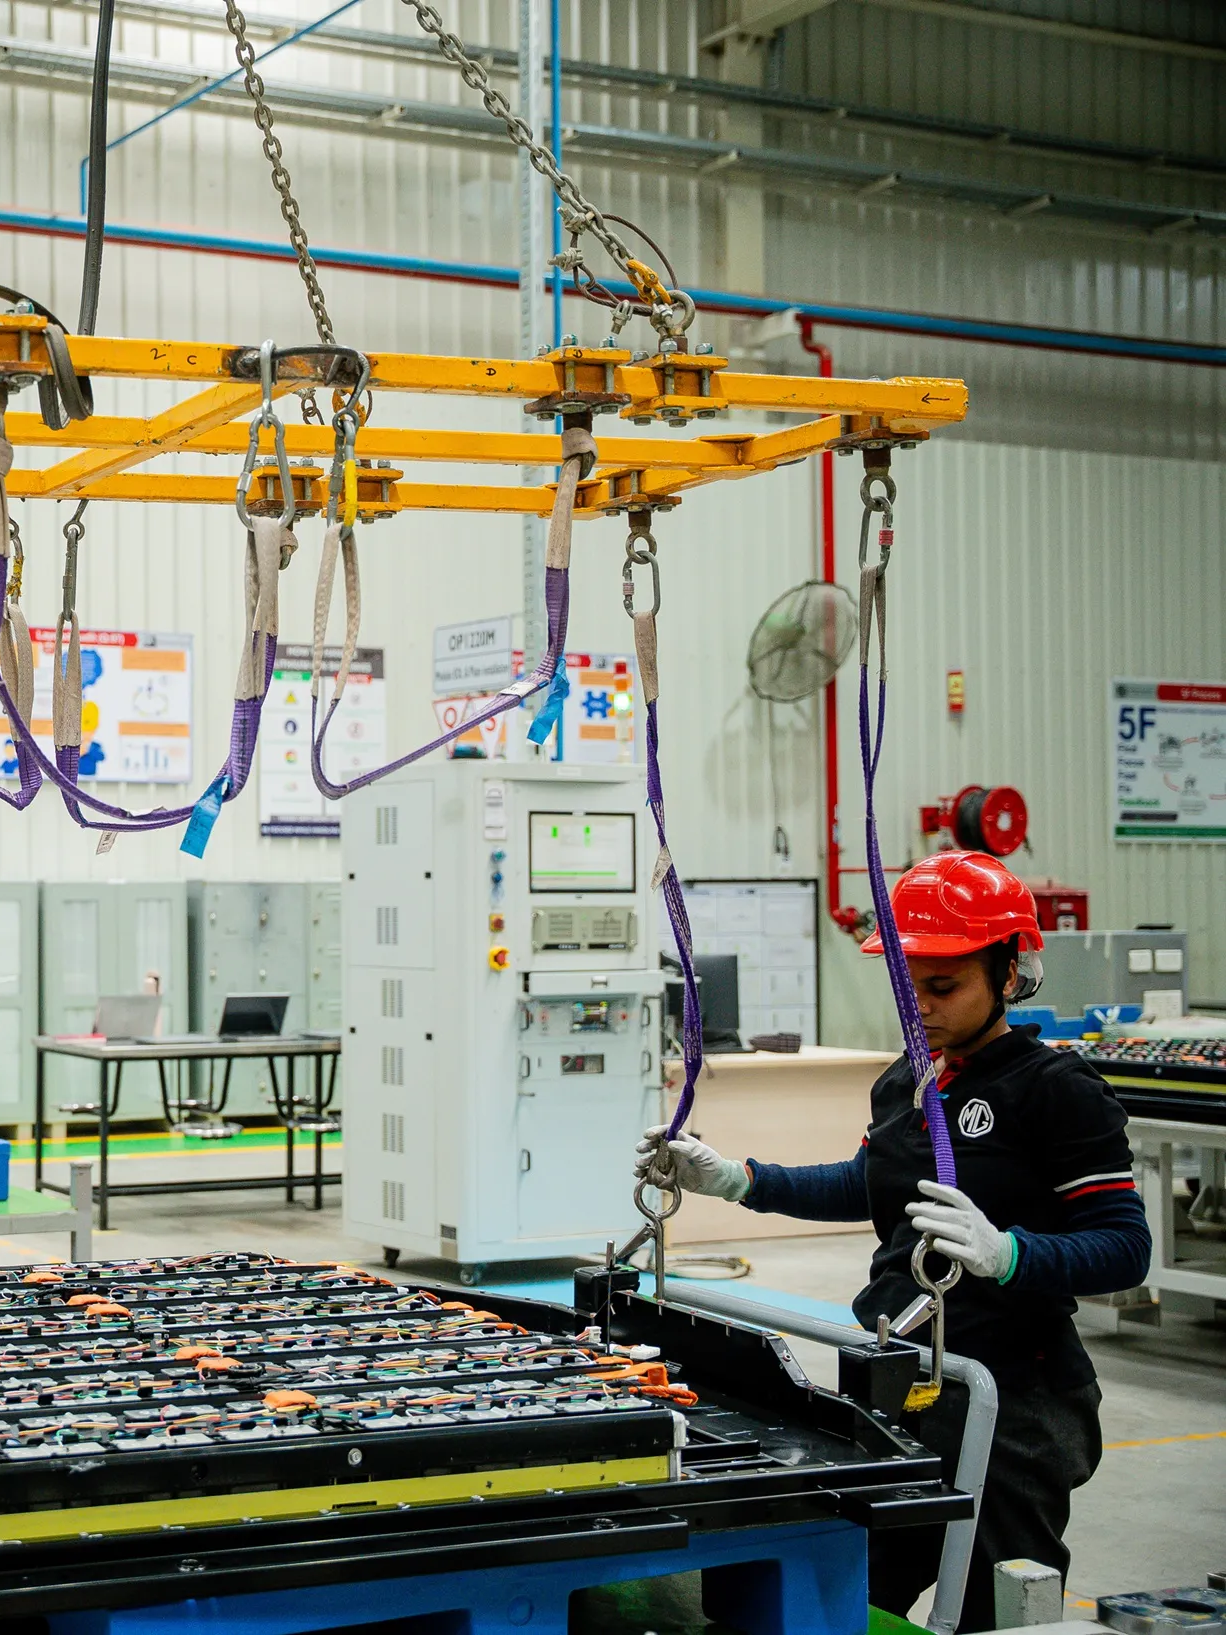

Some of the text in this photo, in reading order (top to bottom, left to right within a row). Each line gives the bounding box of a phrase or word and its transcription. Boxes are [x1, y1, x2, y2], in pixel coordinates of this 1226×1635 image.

[186, 354, 198, 366] C
[1118, 706, 1156, 740] 5F
[960, 1101, 992, 1135] MG
